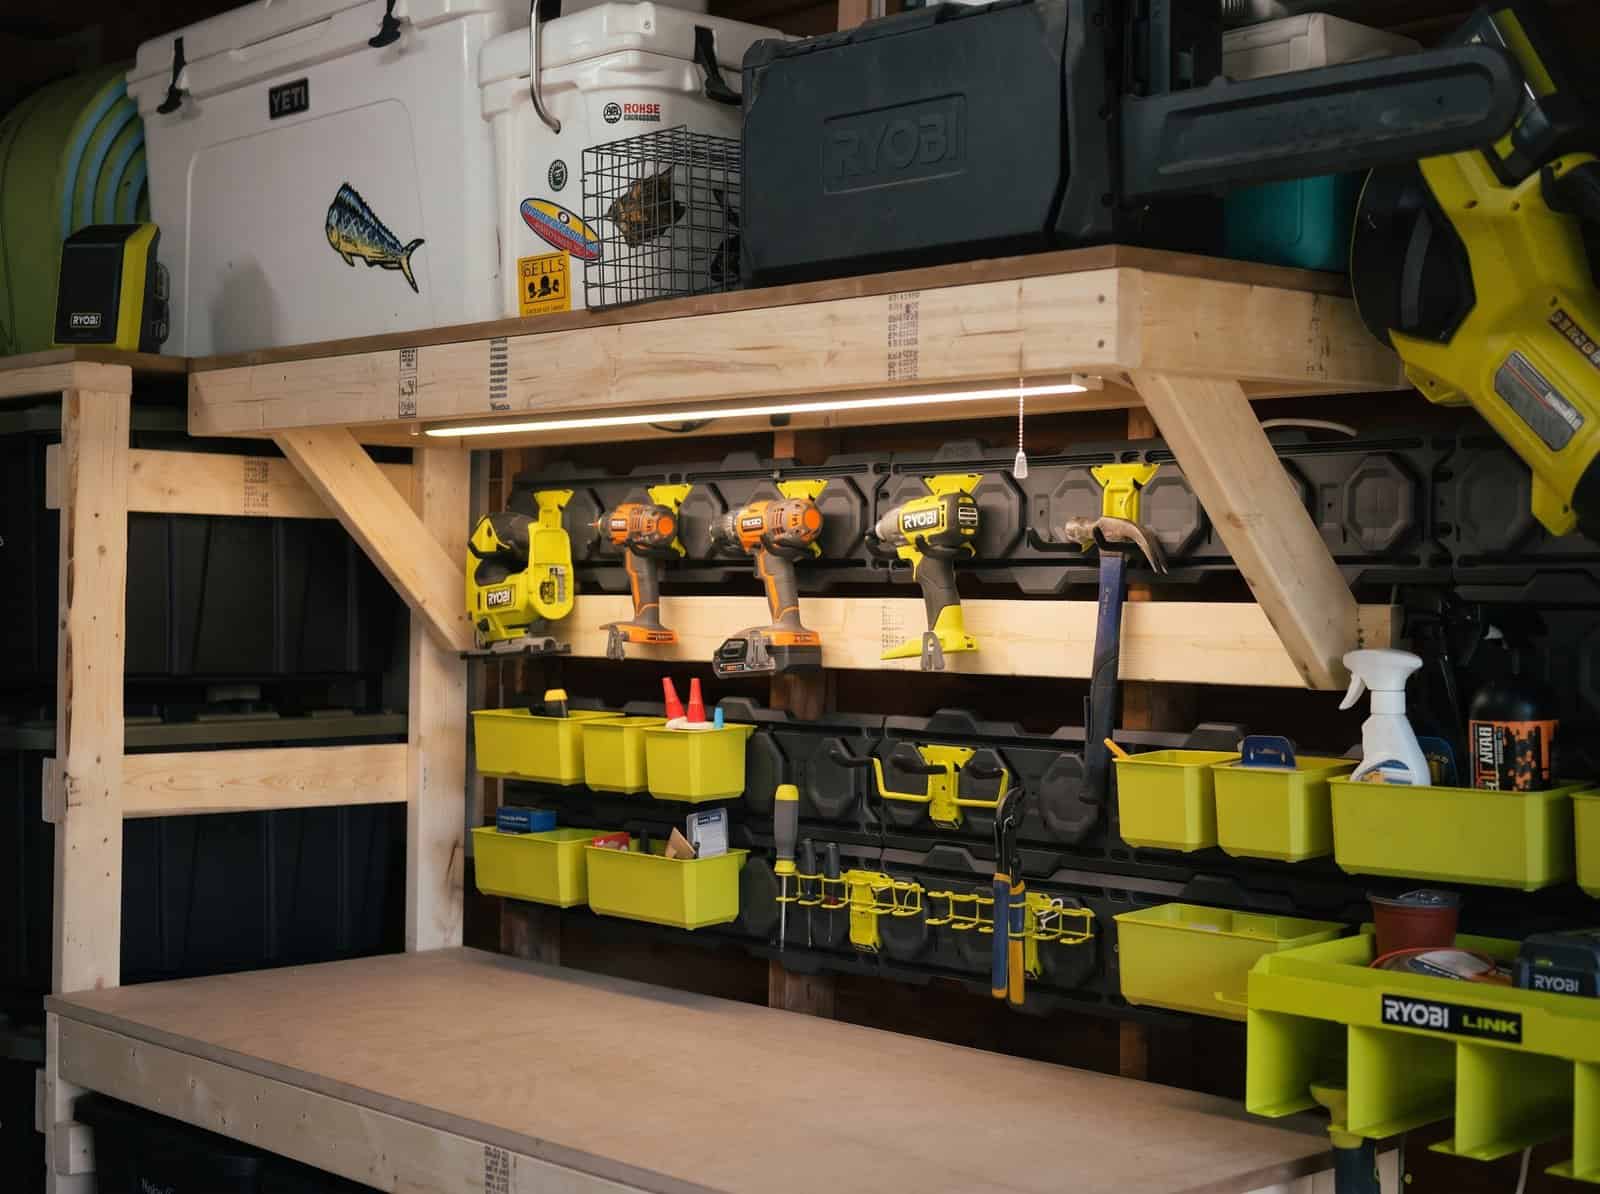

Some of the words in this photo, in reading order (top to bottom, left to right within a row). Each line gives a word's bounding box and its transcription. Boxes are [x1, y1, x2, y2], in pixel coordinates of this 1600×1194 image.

[271, 86, 305, 113] YETI
[829, 111, 959, 181] RYOBI
[72, 315, 99, 325] RYOBI
[903, 510, 938, 529] RYOBI
[487, 590, 511, 606] RYOBI
[1534, 974, 1580, 994] RYOBI
[1383, 1000, 1449, 1029] RYOBI
[1462, 1014, 1519, 1035] LINK
